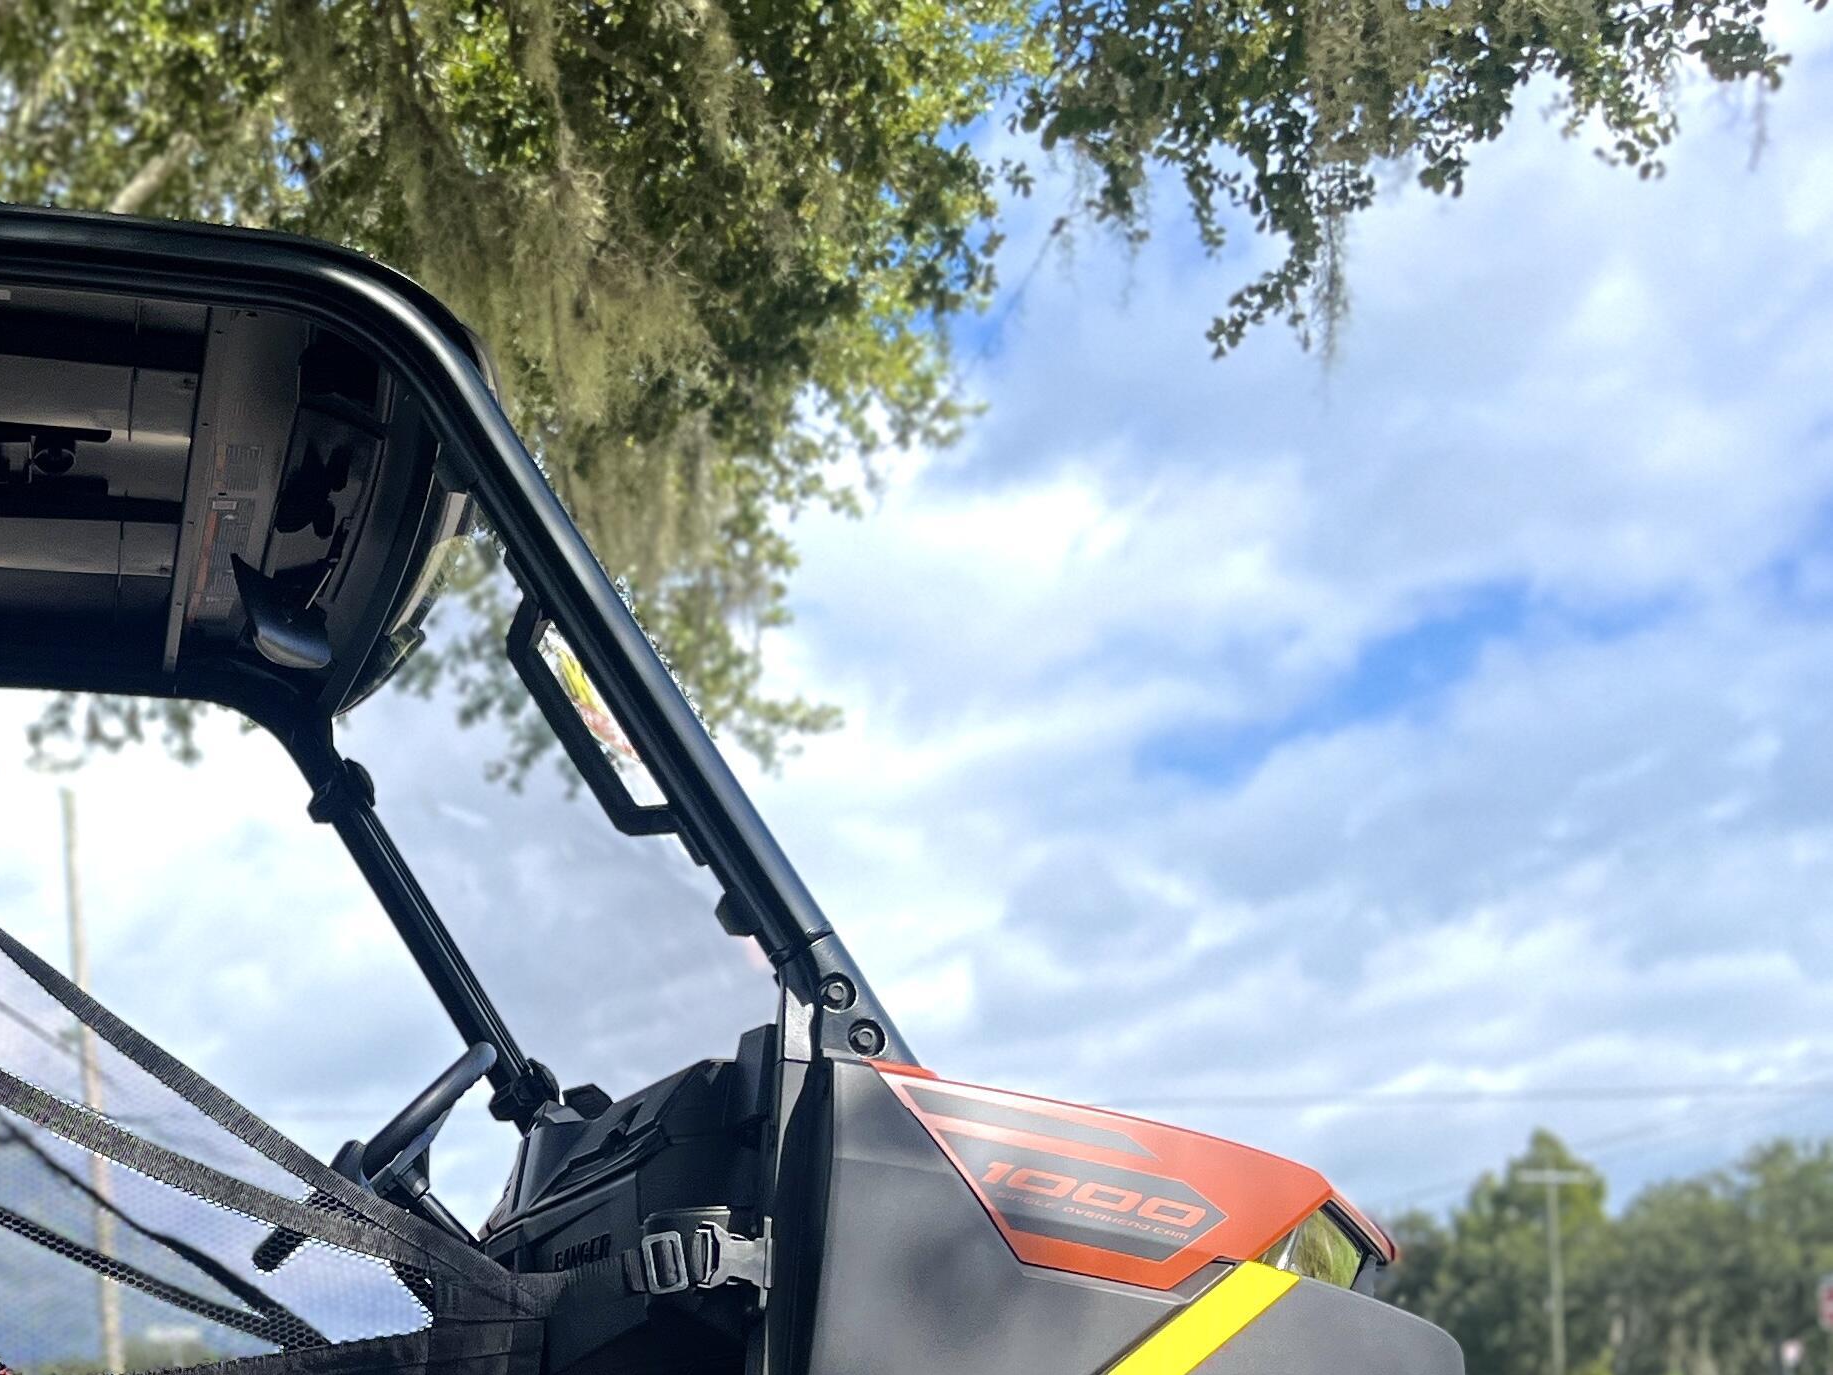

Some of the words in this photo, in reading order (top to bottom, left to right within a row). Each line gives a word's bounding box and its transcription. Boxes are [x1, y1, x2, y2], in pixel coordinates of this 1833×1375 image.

[981, 1162, 1206, 1228] 1000
[995, 1191, 1059, 1210] SINGLE
[1062, 1207, 1151, 1230] OVERHEAD
[1152, 1227, 1190, 1241] CAM
[554, 1234, 611, 1269] RANGER
